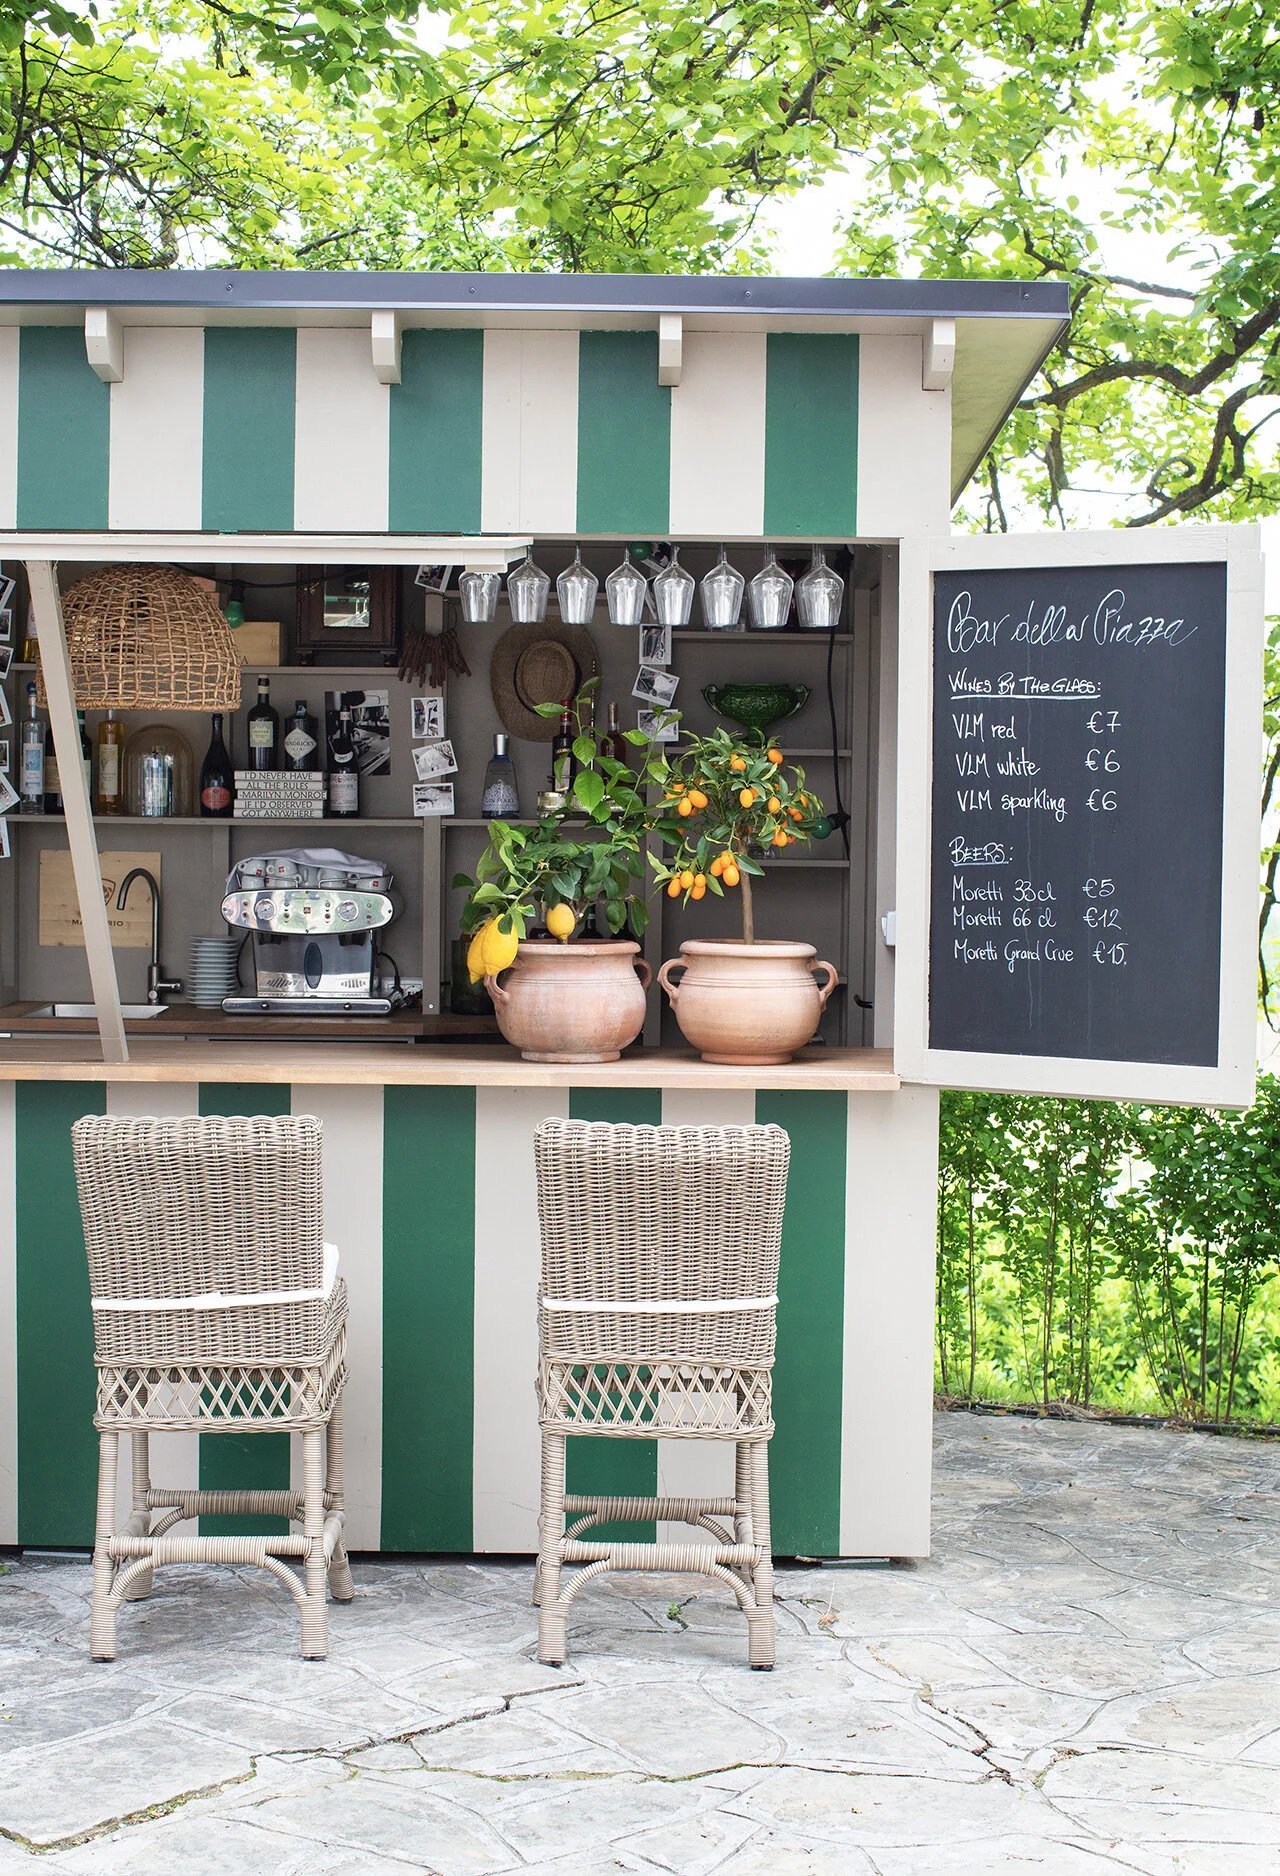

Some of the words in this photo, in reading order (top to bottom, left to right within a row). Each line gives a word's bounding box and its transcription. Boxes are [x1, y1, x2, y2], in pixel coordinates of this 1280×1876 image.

[947, 591, 1010, 653] Bar
[1010, 600, 1089, 646] della
[1093, 589, 1198, 646] Piazza
[952, 712, 985, 742] VLM
[991, 716, 1017, 740] red
[1086, 711, 1121, 733] €7
[245, 772, 257, 780] I'D
[259, 772, 287, 780] NEVER
[290, 772, 313, 780] HAVE
[955, 751, 990, 778] VLM
[996, 747, 1041, 777] white
[1085, 748, 1121, 773] €6
[246, 782, 261, 790] ALL
[264, 782, 280, 790] THE
[283, 782, 308, 790] RULES
[284, 791, 326, 799] MONROE
[242, 810, 262, 818] GOT
[264, 810, 314, 818] ANYWHERE
[245, 801, 252, 809] IF
[254, 801, 266, 809] I'D
[269, 801, 313, 809] OBSERVED
[957, 789, 992, 812] VLM
[1001, 787, 1069, 823] sparkling
[1085, 789, 1118, 812] €6
[949, 836, 1013, 864] BEERS:
[952, 875, 1003, 902] Moretti
[1082, 878, 1115, 899] €5
[953, 905, 1002, 930] Moretti
[1012, 907, 1031, 928] 66
[1082, 907, 1122, 929] €12
[954, 938, 998, 964] Moretti
[1004, 939, 1041, 973] Grand
